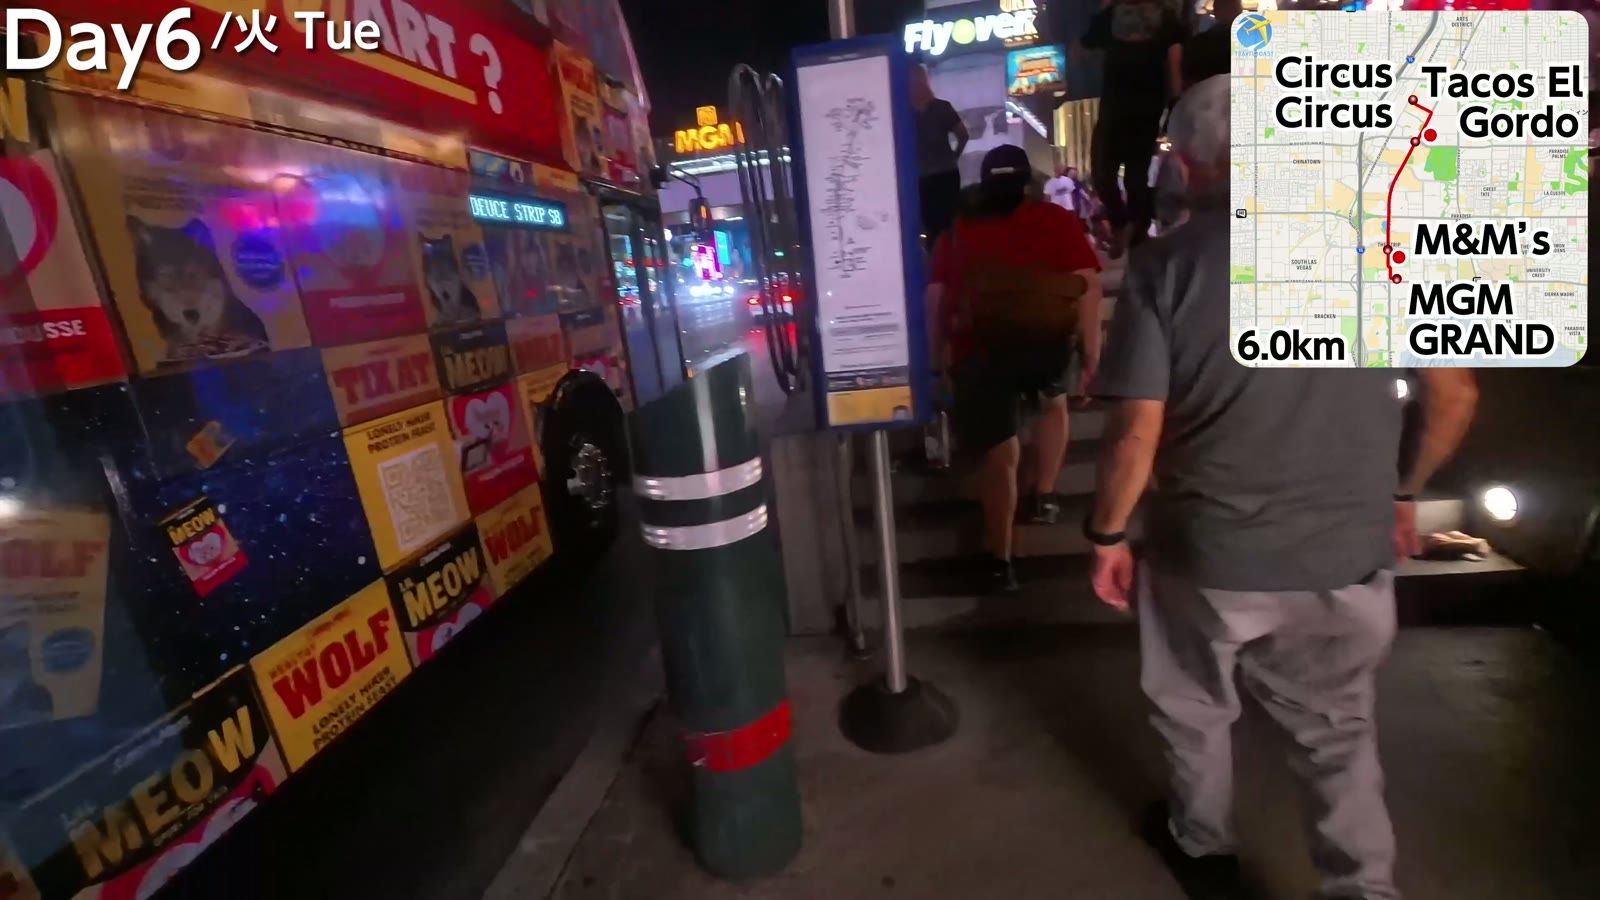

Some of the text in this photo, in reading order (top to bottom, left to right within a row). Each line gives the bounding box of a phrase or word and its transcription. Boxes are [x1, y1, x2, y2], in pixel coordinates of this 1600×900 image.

[469, 196, 565, 225] DEUCE STRIP SB
[402, 547, 480, 627] MEOW
[273, 608, 389, 719] WOLF
[70, 705, 256, 879] MEOW
